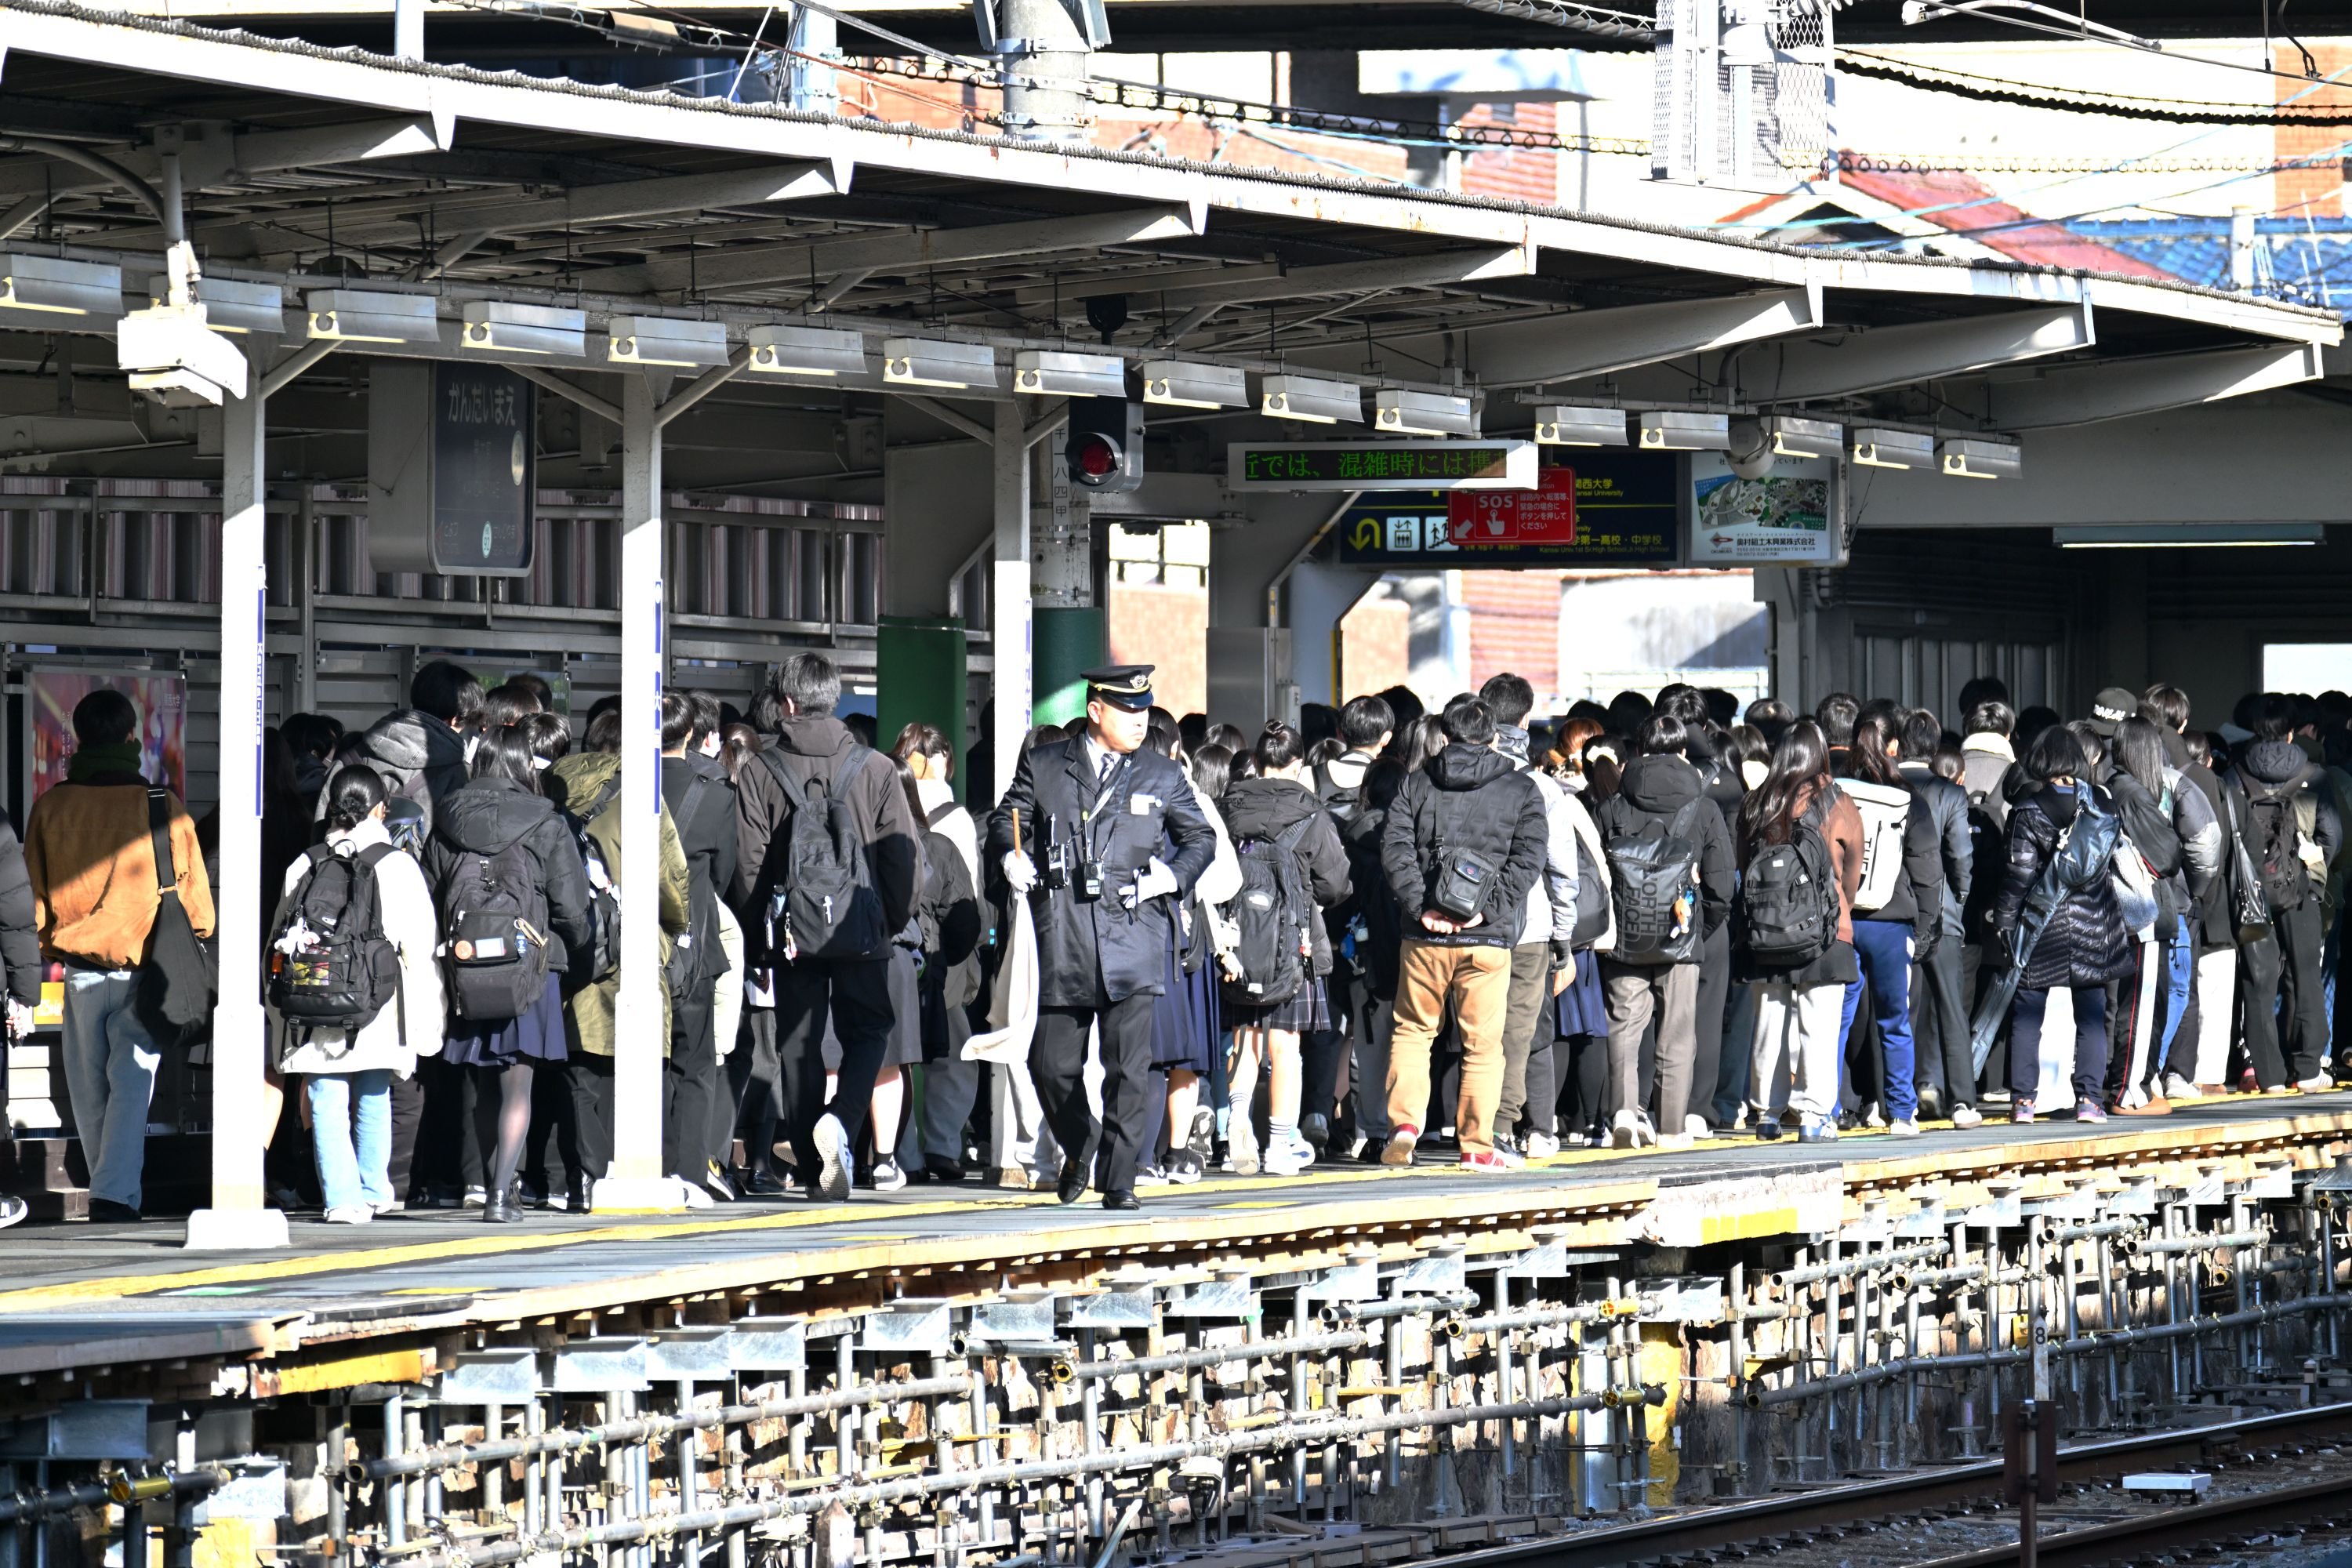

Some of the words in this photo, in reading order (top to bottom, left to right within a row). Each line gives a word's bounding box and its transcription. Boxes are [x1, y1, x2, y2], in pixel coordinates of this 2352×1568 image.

[448, 382, 516, 426] かんだいまえ
[1479, 495, 1513, 508] SOS
[1520, 512, 1566, 521] ボタンを押して
[1624, 885, 1642, 933] FACE
[2035, 1327, 2045, 1345] 8
